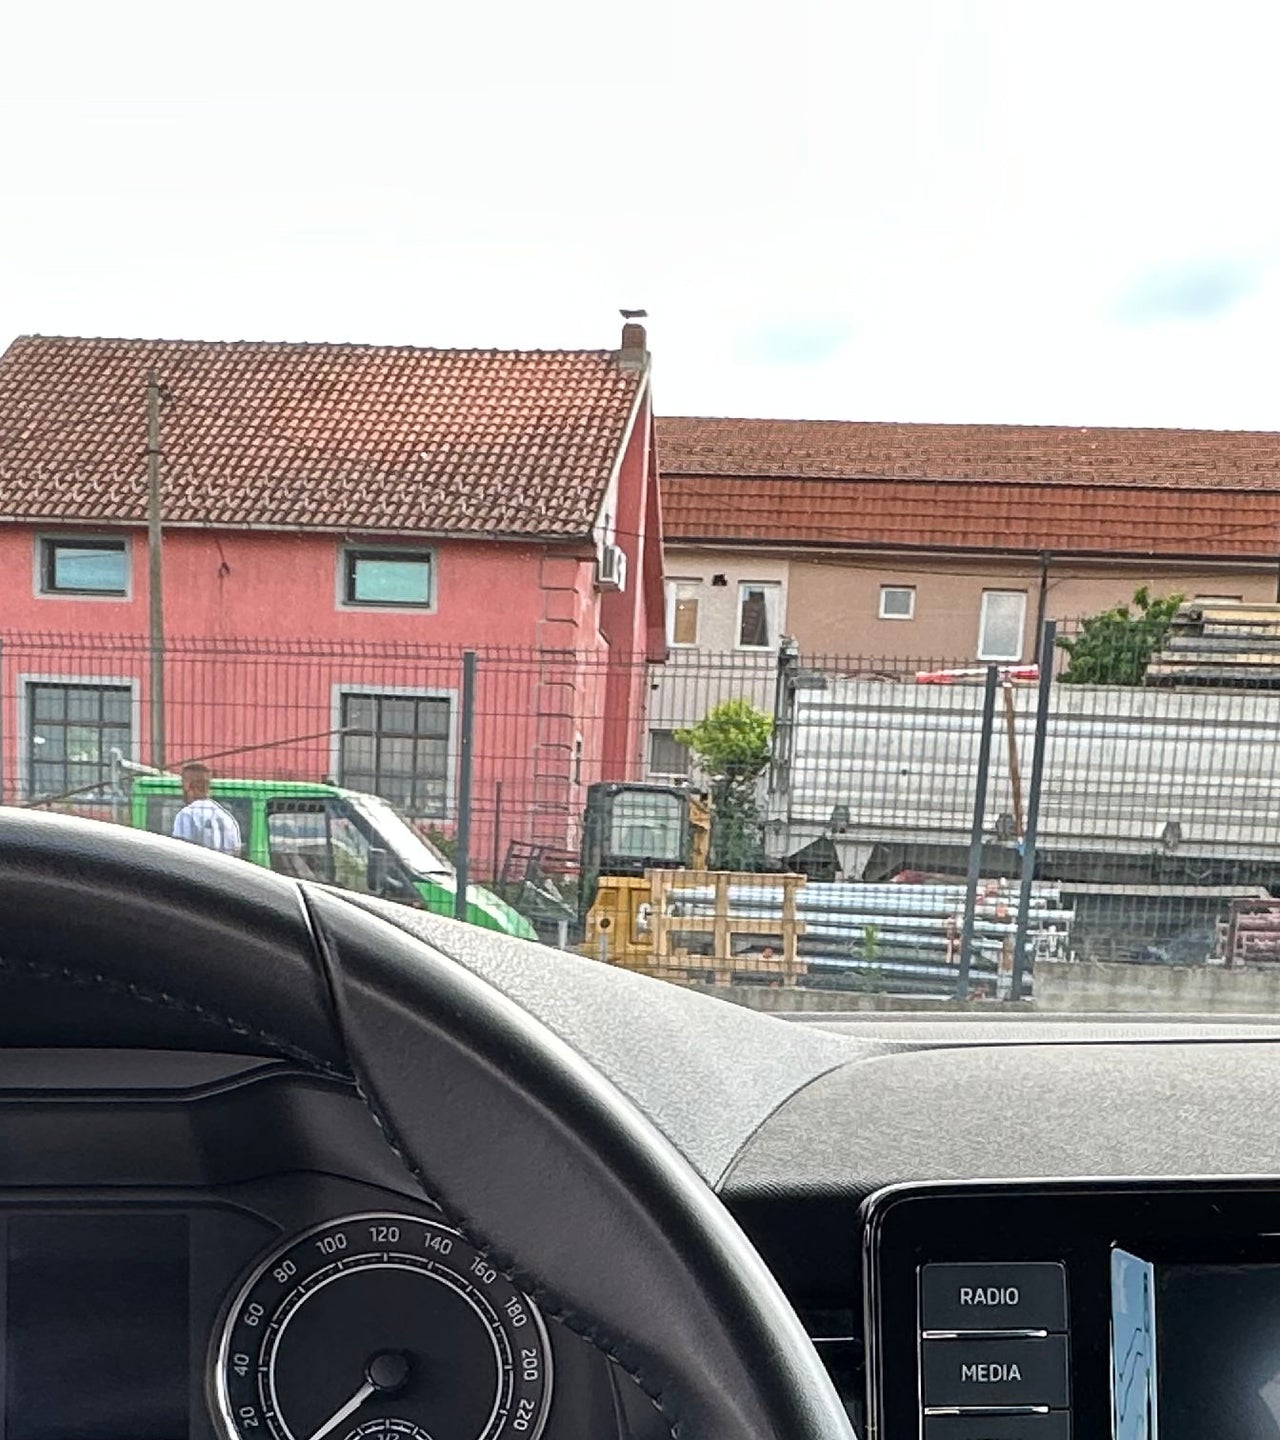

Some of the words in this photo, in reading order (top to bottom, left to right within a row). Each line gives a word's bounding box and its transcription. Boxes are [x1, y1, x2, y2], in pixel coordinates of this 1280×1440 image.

[315, 1232, 347, 1256] 100
[369, 1227, 400, 1243] 120
[424, 1232, 453, 1256] 140
[273, 1259, 297, 1284] 80
[471, 1256, 497, 1285] 160
[960, 1287, 1019, 1305] RADIO
[244, 1303, 265, 1327] 60
[504, 1296, 528, 1327] 180
[234, 1353, 249, 1377] 40
[521, 1348, 538, 1381] 200
[961, 1364, 1021, 1382] MEDIA
[238, 1406, 259, 1429] 20
[513, 1400, 535, 1431] 220
